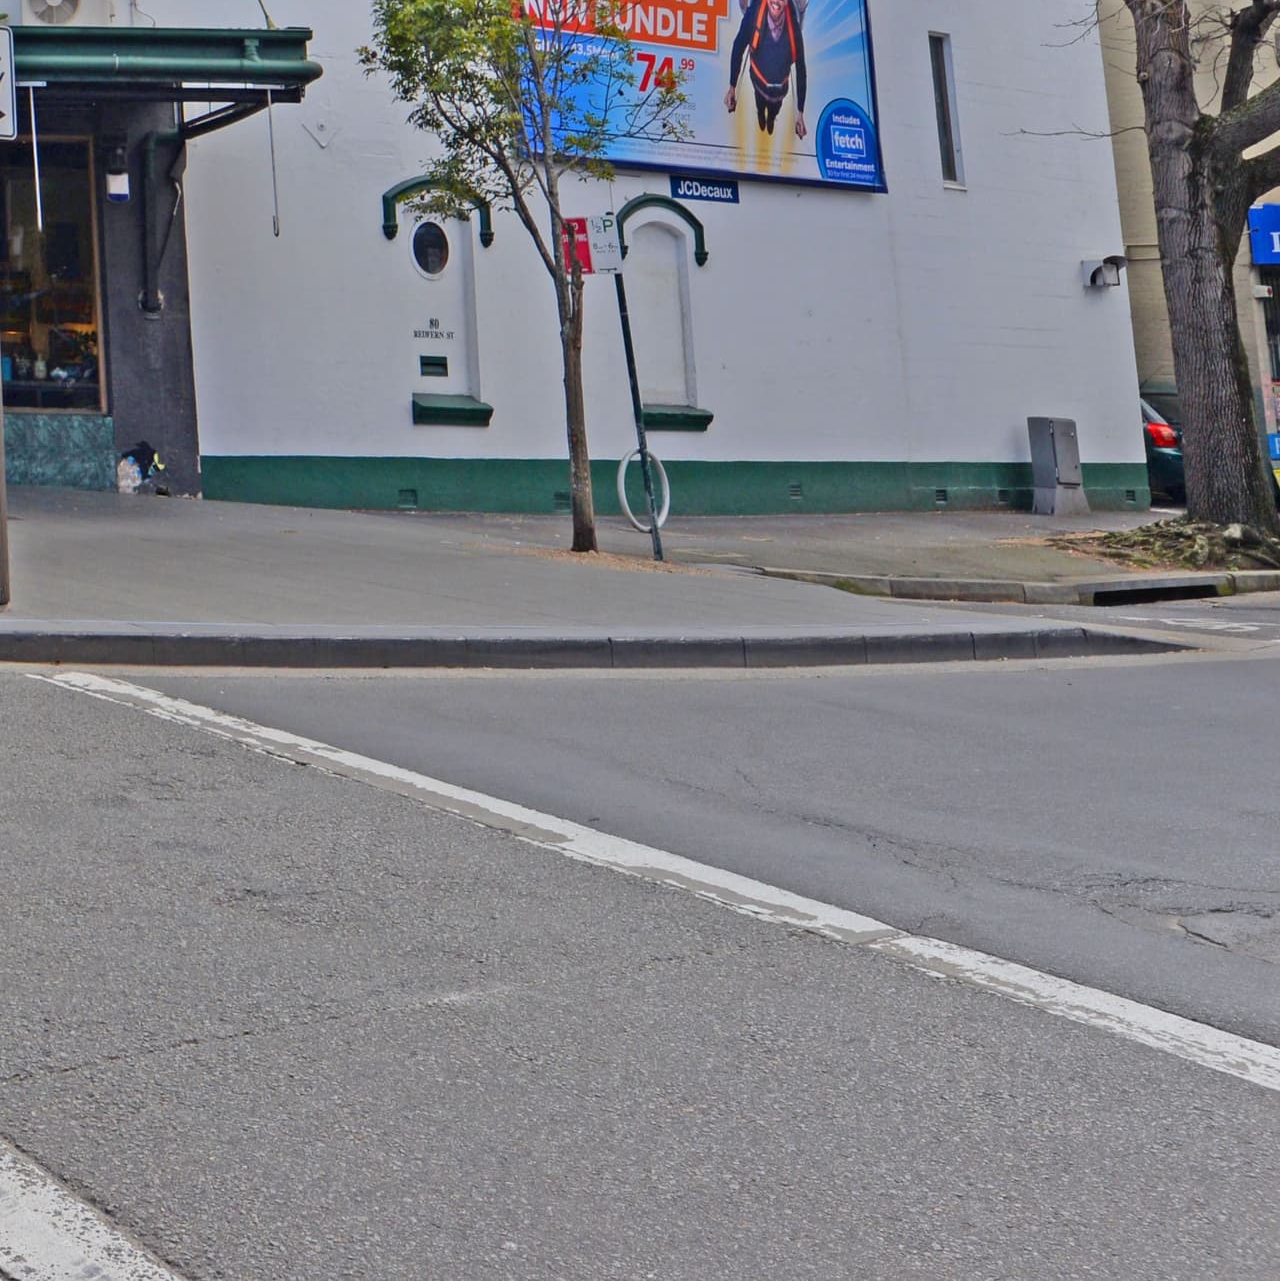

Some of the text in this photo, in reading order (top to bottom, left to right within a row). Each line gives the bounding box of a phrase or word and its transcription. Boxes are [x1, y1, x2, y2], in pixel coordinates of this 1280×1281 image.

[832, 113, 860, 126] Includes
[834, 131, 863, 150] fetch
[825, 158, 876, 172] Entertainment
[677, 180, 733, 199] JCDecaux
[429, 317, 440, 329] 80
